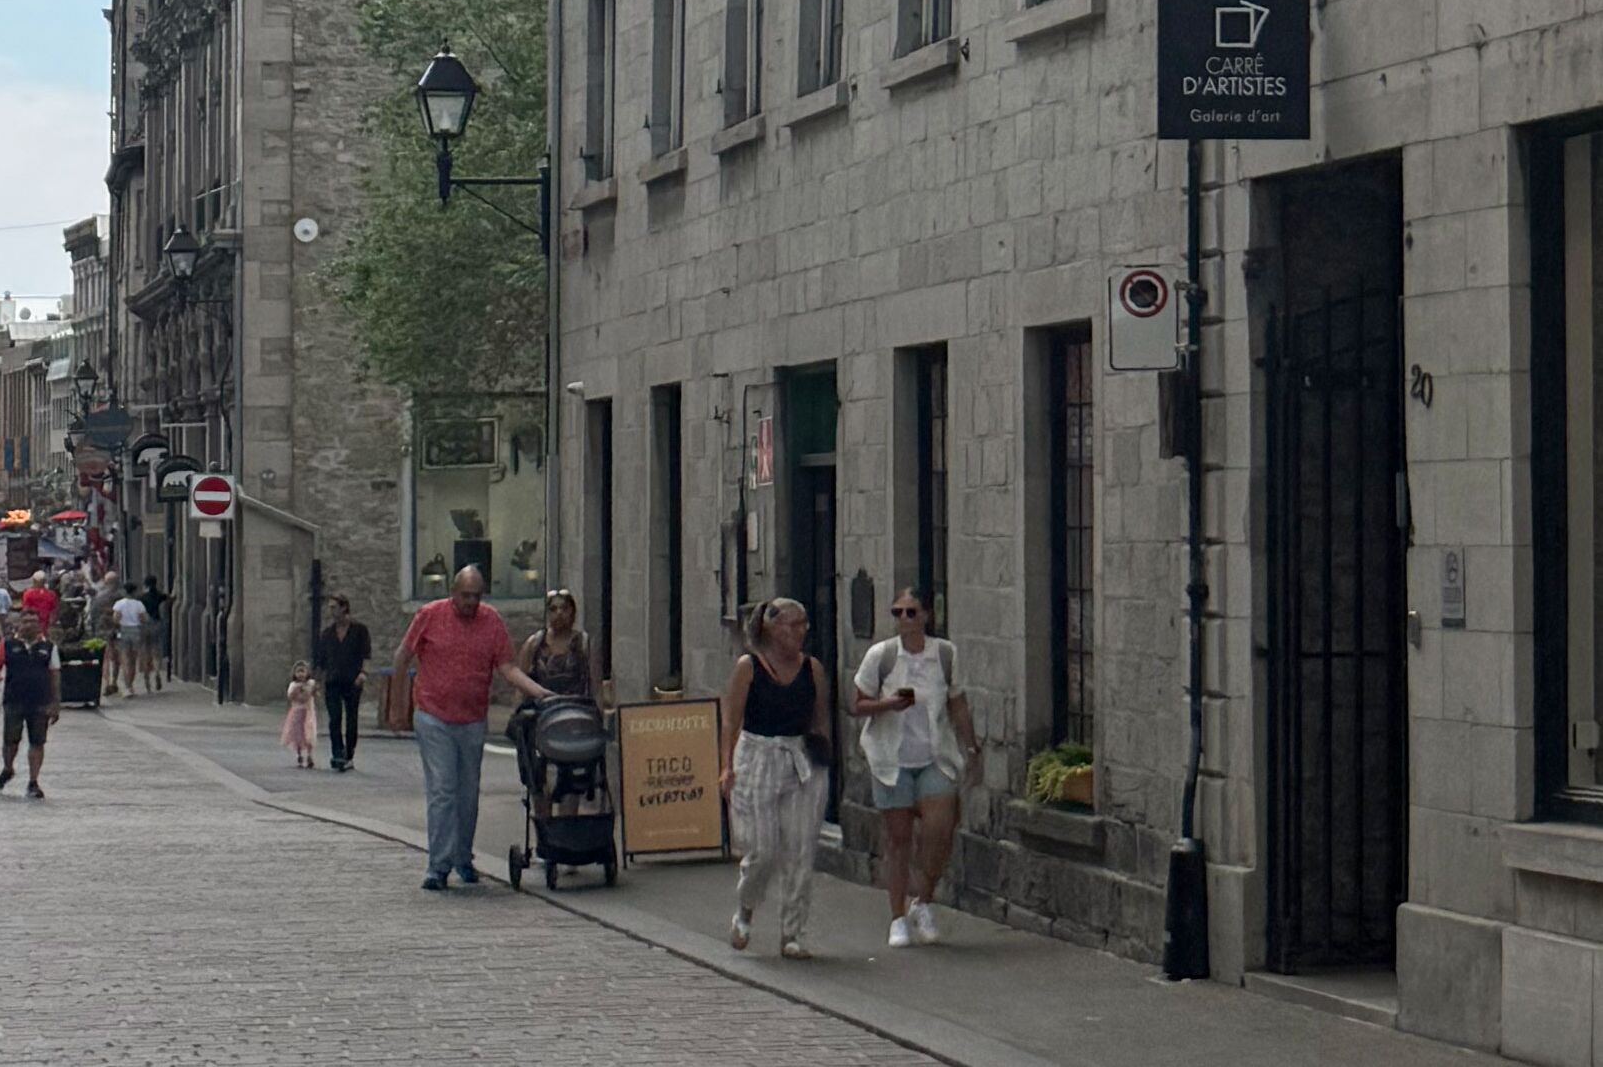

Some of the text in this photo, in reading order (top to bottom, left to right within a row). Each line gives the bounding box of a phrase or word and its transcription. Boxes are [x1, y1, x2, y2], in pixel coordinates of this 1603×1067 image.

[1205, 53, 1265, 75] CARRÉ
[1183, 76, 1286, 96] D'ARTISTES
[1190, 108, 1280, 123] Galerie d'art
[1410, 363, 1433, 408] 20
[646, 756, 692, 774] TACO
